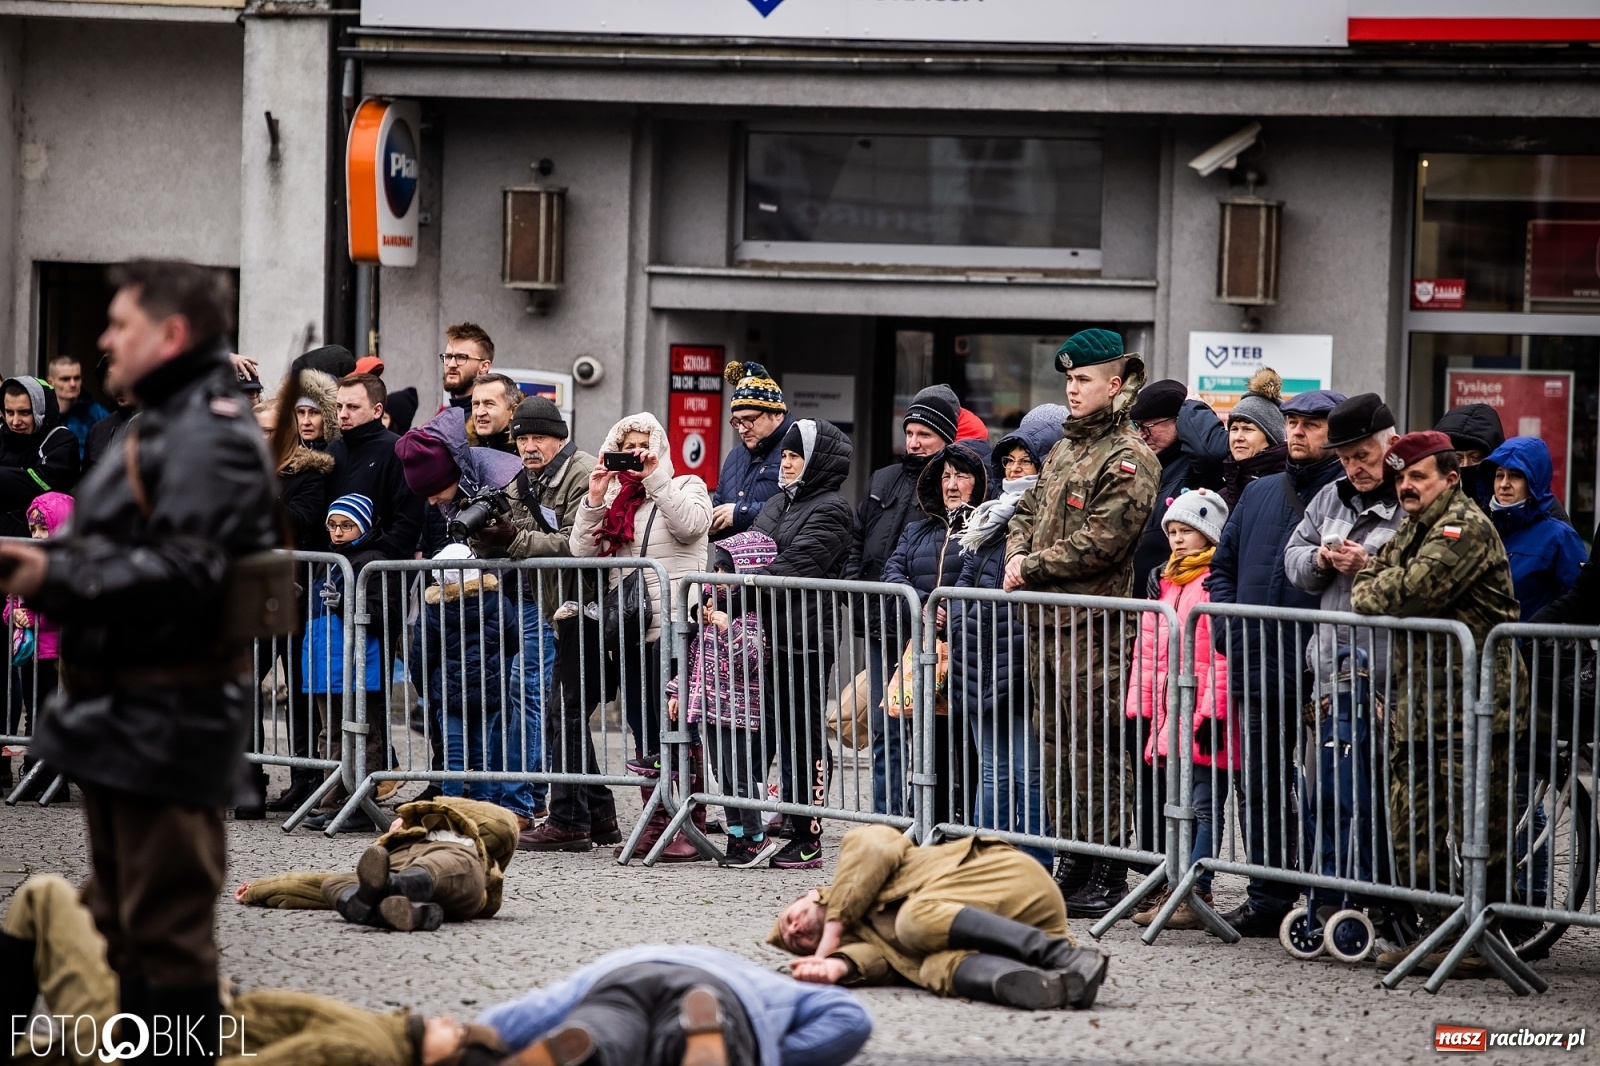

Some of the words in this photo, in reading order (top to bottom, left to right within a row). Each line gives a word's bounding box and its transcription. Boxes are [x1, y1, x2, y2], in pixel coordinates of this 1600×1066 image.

[383, 234, 413, 248] BANKOMAT
[1232, 346, 1262, 359] TEB
[683, 355, 711, 371] SZKOŁA
[1456, 379, 1502, 396] Tysiące
[809, 759, 829, 834] aidas
